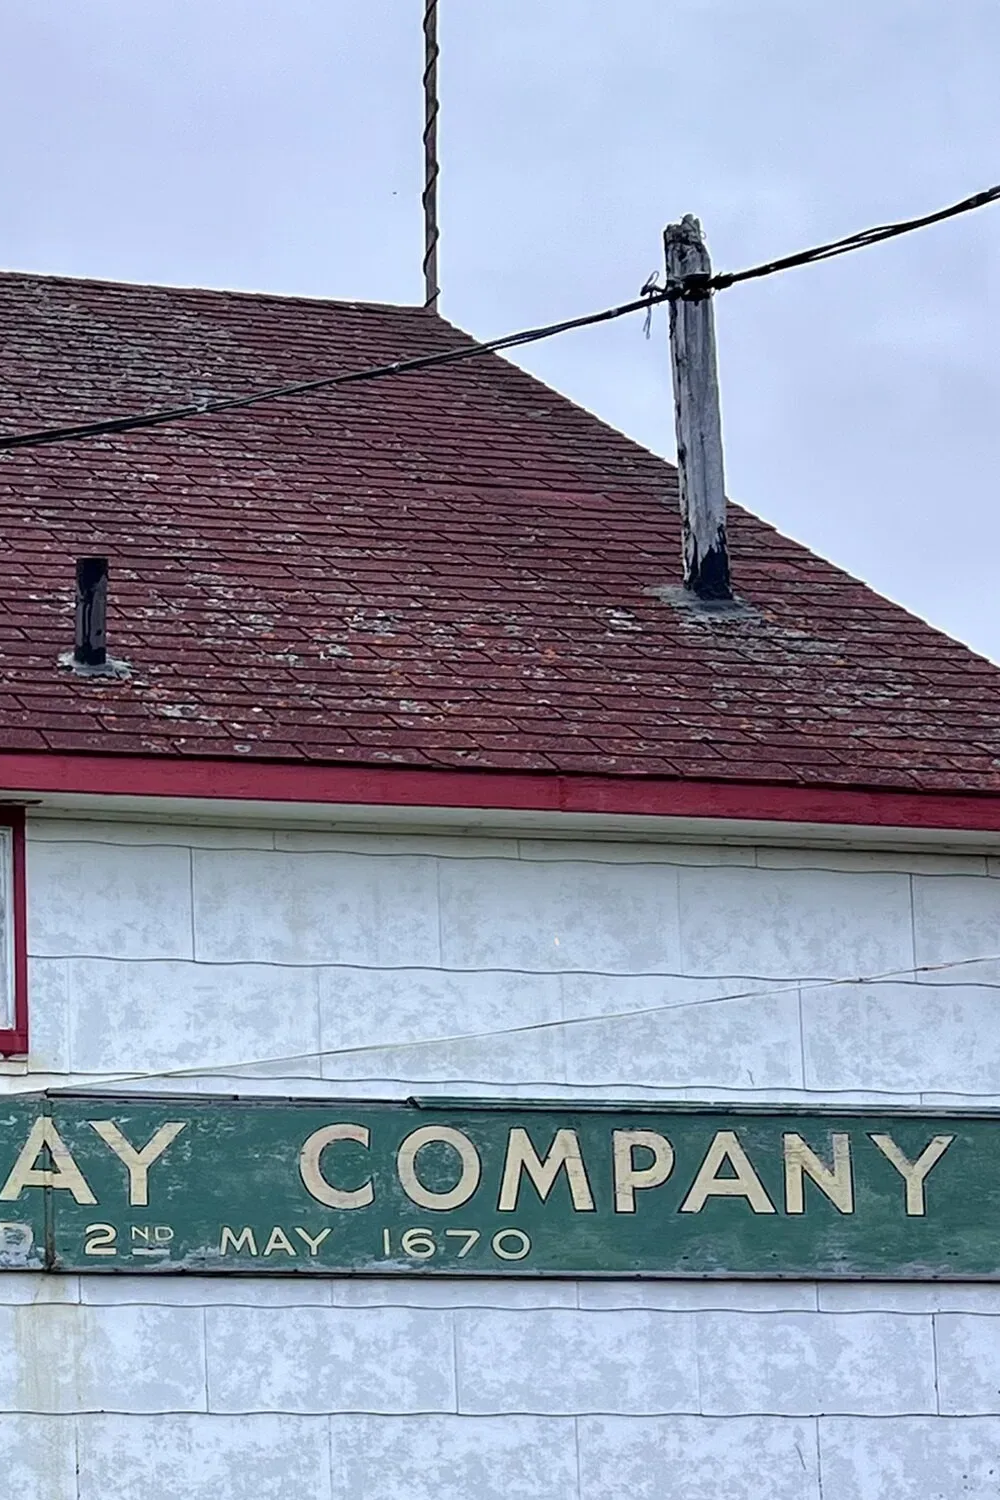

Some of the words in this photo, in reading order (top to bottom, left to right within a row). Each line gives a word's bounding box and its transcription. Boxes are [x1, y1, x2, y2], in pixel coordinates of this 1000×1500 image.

[299, 1123, 954, 1216] COMPANY
[219, 1226, 331, 1257] MAY
[381, 1228, 533, 1261] 1670
